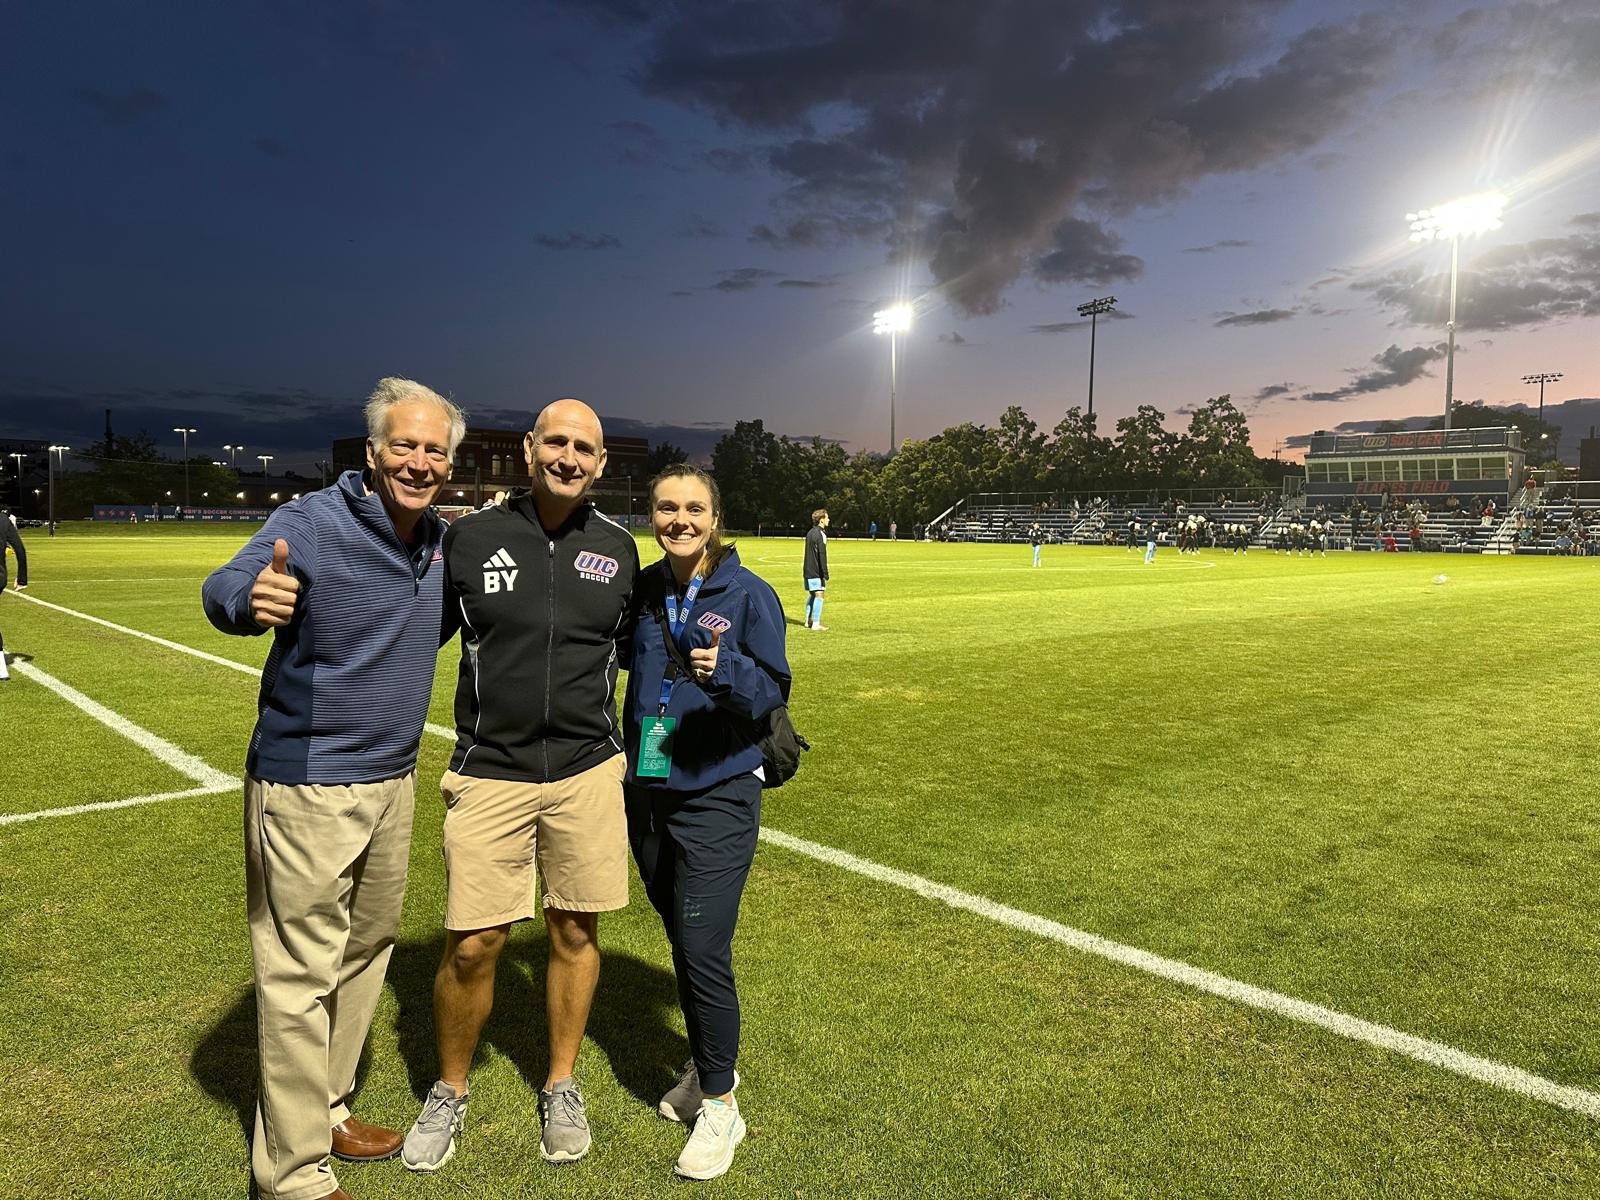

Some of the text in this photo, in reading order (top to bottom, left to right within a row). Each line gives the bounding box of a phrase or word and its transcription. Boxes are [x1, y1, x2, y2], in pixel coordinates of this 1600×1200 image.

[1364, 436, 1387, 447] UIC
[1411, 480, 1450, 493] FIELD
[575, 552, 618, 577] UIC
[483, 569, 519, 594] BY
[580, 571, 610, 584] SOCCER
[698, 612, 731, 632] UIC
